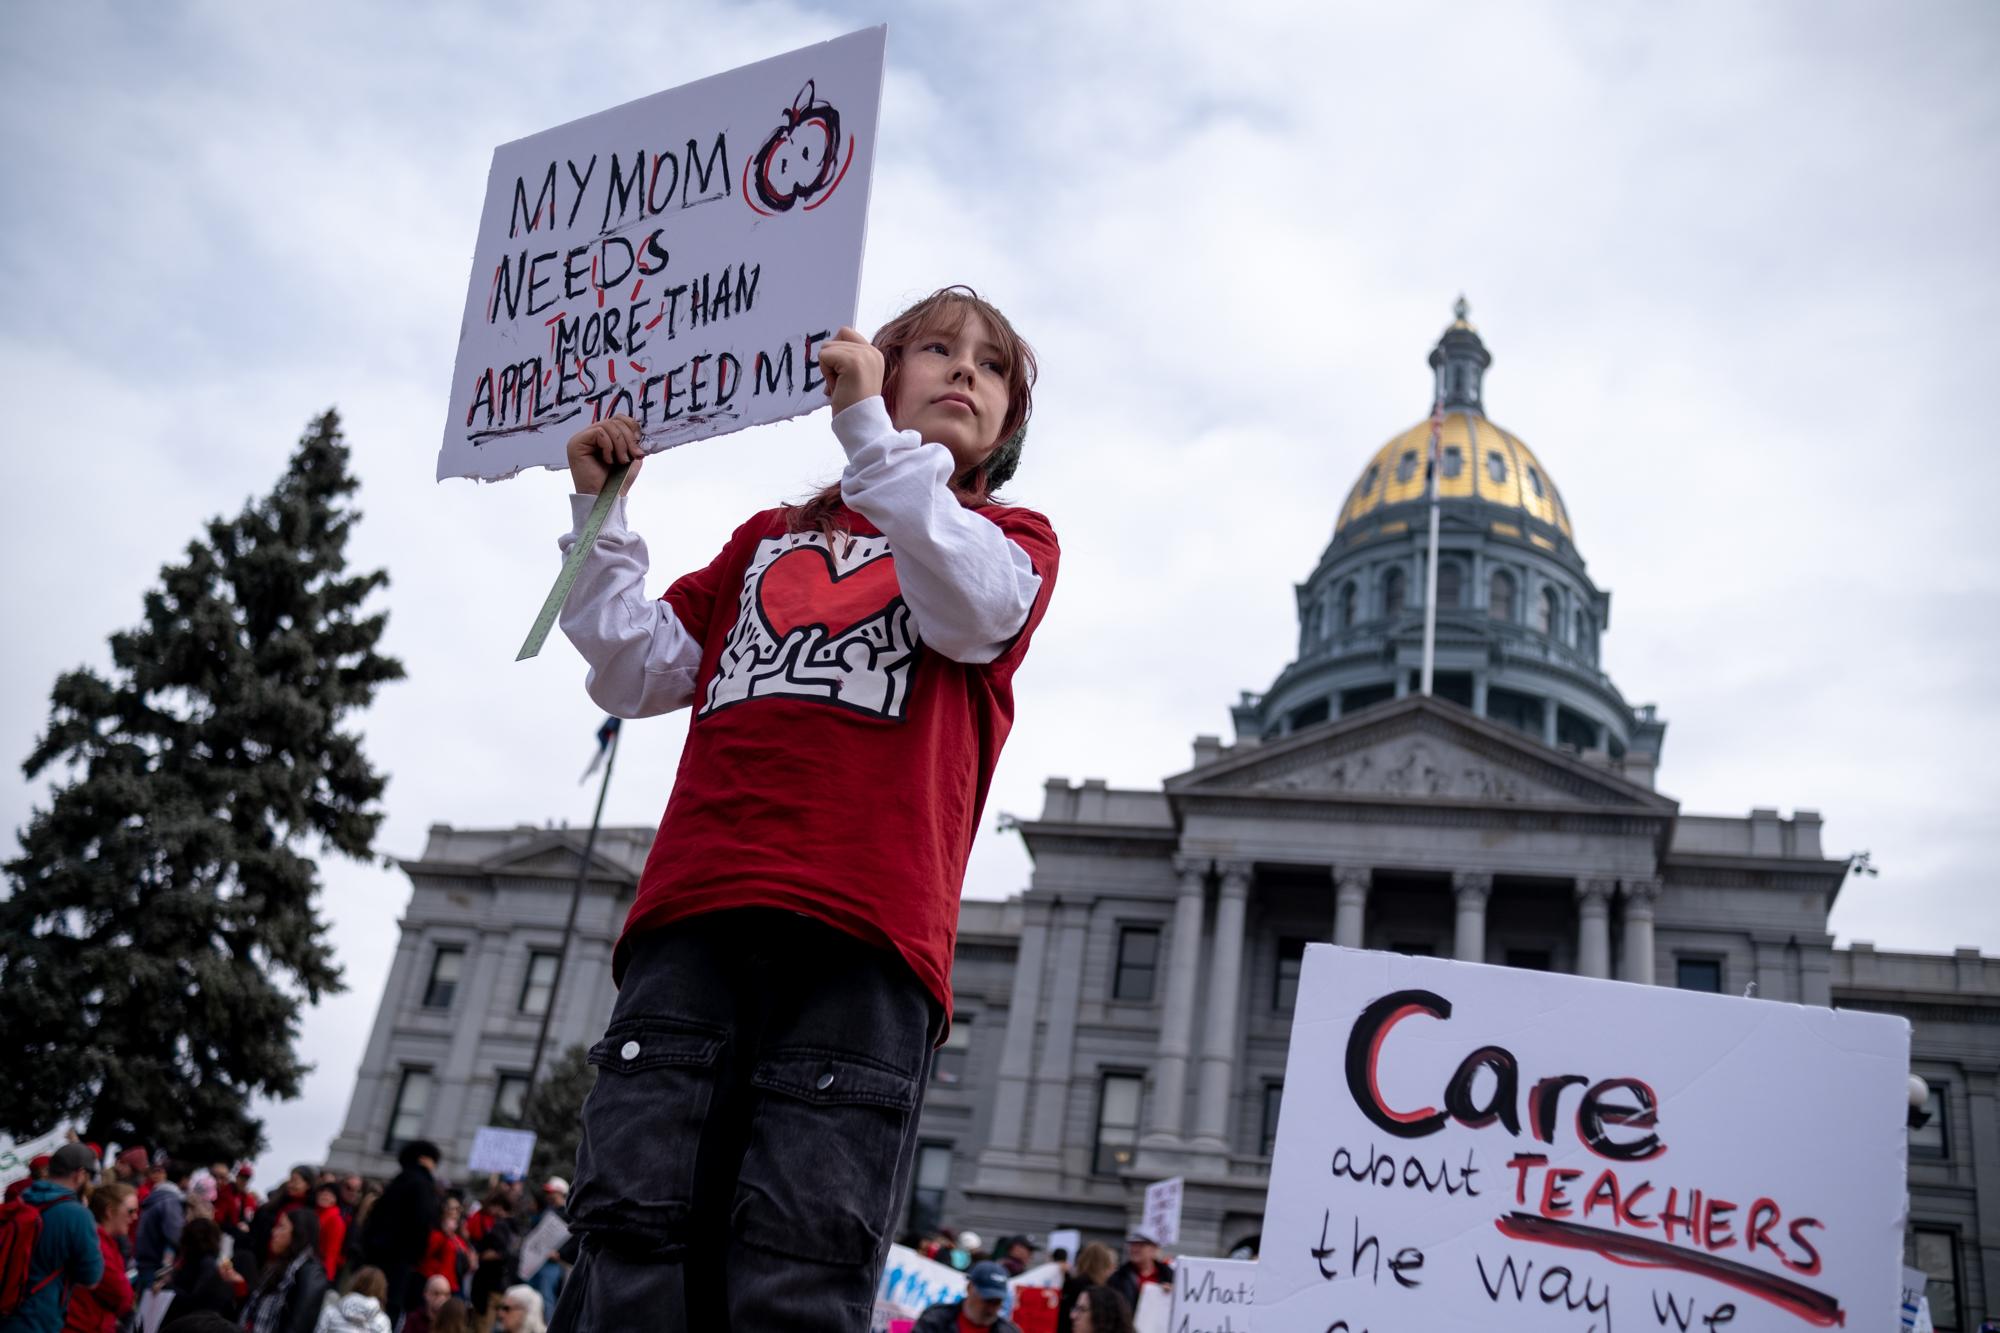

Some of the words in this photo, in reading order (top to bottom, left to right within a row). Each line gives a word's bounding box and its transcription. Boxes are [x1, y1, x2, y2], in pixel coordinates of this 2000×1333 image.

[509, 154, 597, 238] MY
[599, 132, 732, 236] MOM
[488, 229, 669, 324] NEEDS
[553, 299, 651, 364] MORE
[663, 262, 761, 340] THAN
[467, 347, 600, 428] APPLES
[638, 351, 742, 428] FEED
[752, 330, 831, 397] ME
[1345, 989, 1667, 1161] Care
[1311, 1208, 1425, 1288] the
[1332, 1143, 1481, 1196] about
[1506, 1152, 1825, 1276] TEACHERS
